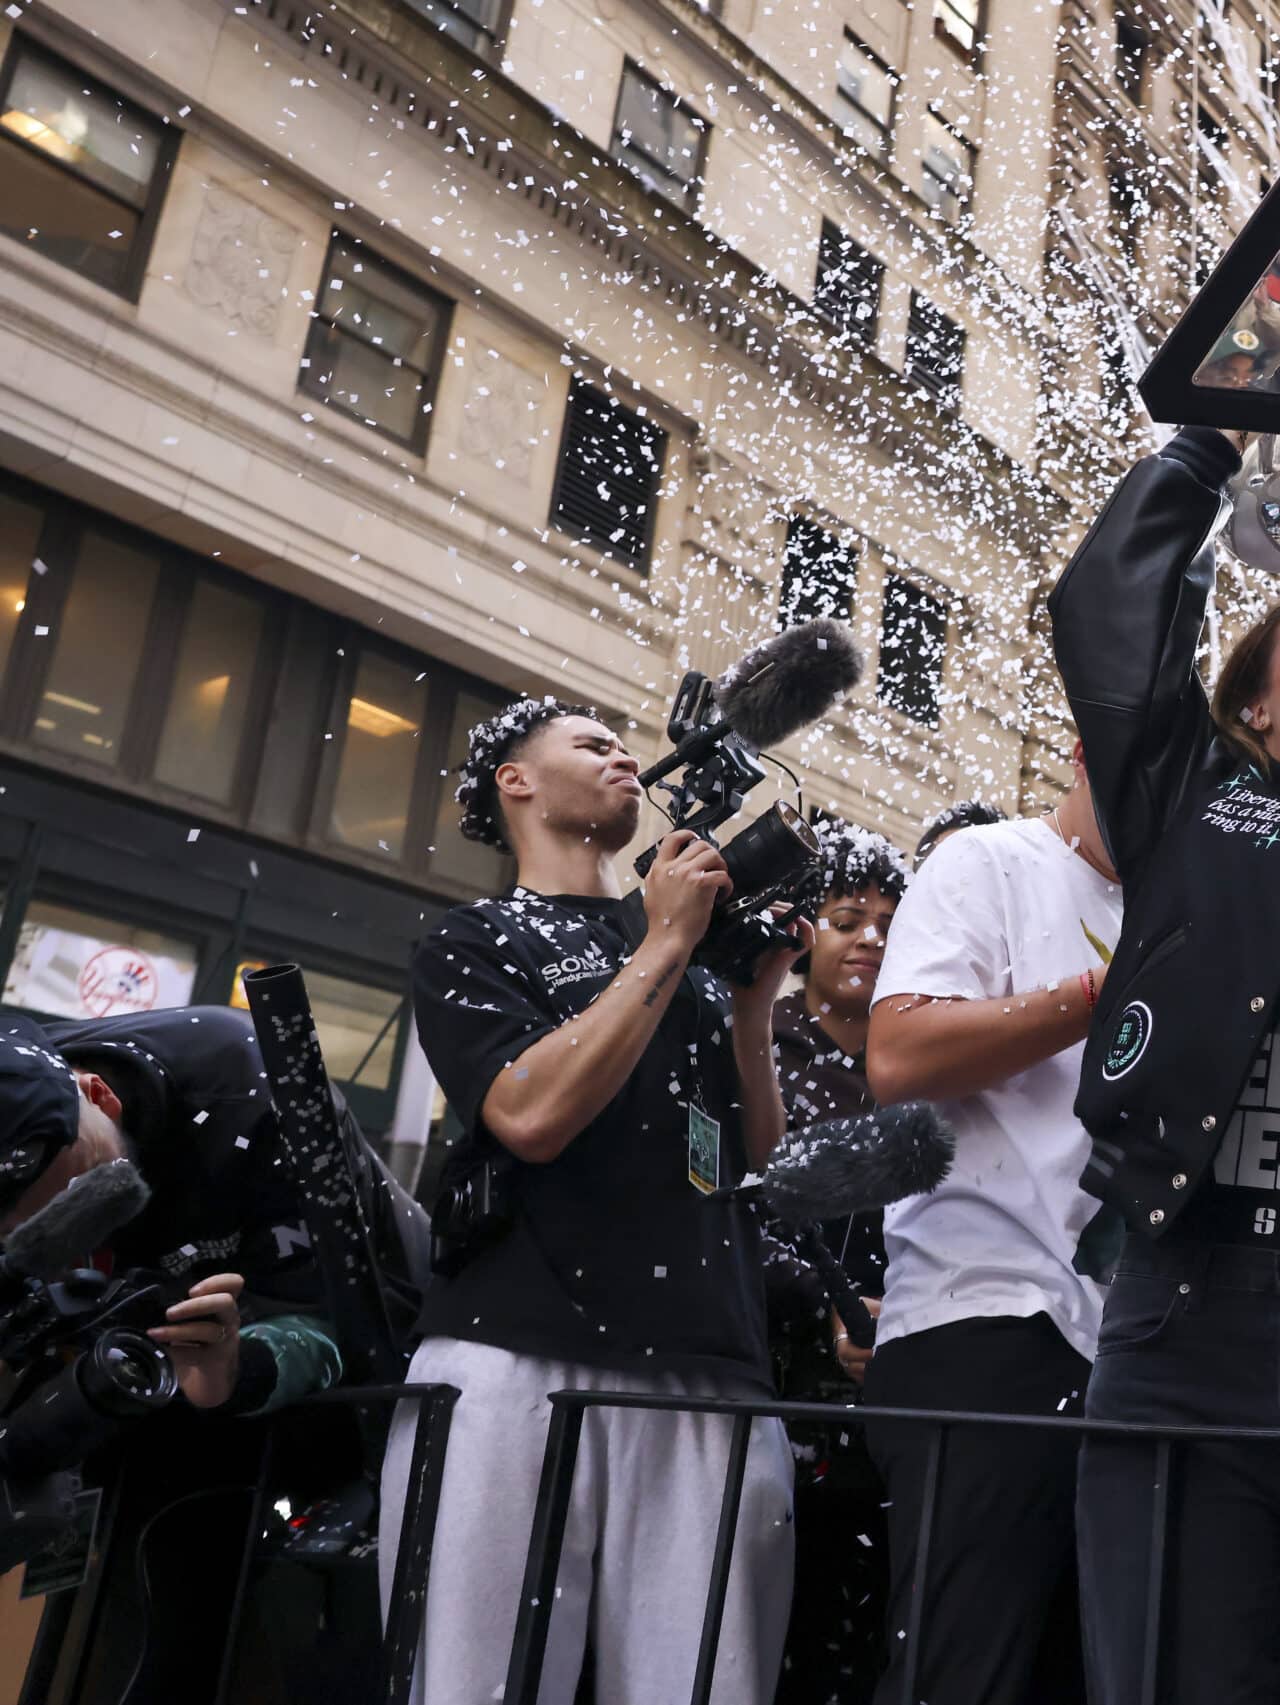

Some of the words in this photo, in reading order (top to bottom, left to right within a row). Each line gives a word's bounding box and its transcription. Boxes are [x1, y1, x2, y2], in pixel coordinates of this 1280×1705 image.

[1208, 799, 1241, 815] has
[1238, 807, 1254, 817] a
[1201, 812, 1242, 833] ring
[1240, 820, 1257, 833] to
[541, 956, 611, 981] SONY
